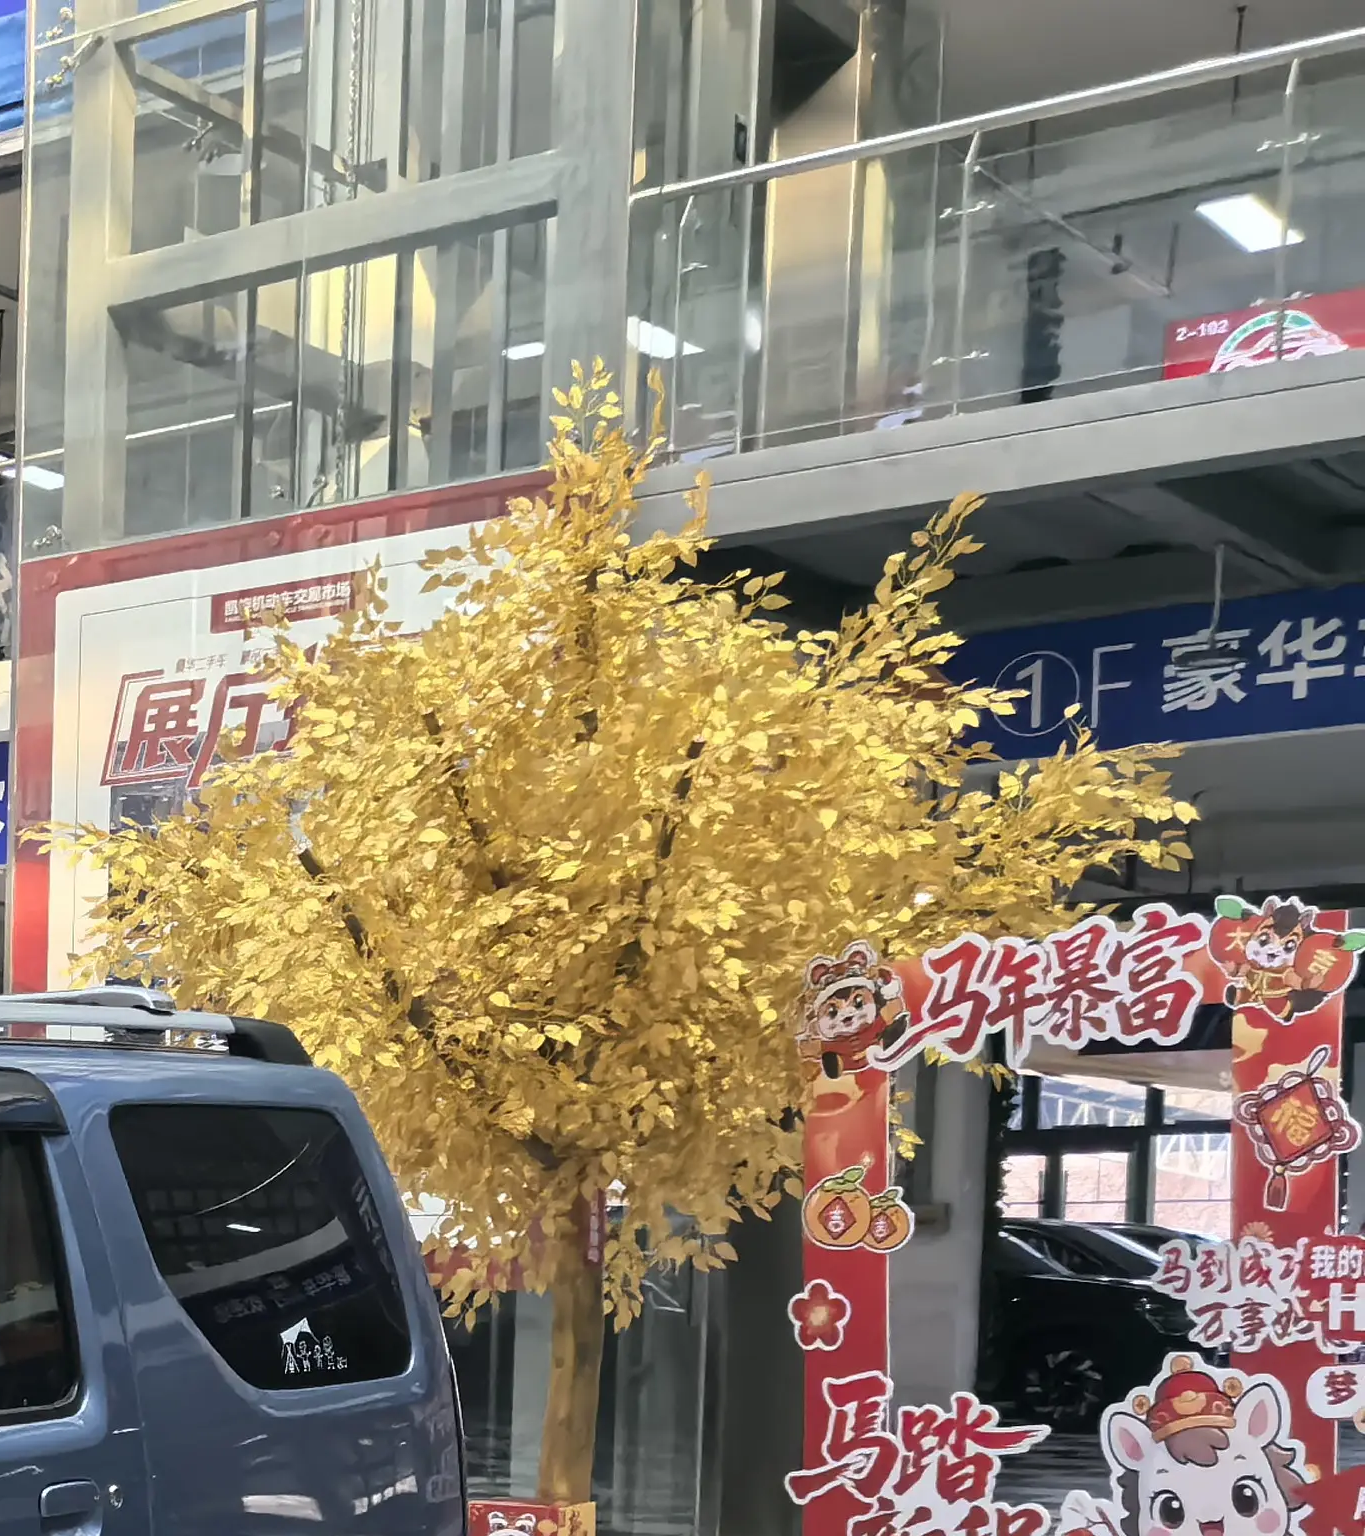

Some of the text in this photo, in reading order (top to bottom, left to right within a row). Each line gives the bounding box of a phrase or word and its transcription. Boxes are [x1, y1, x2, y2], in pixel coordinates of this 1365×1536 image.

[1161, 616, 1365, 713] 豪华
[875, 909, 1205, 1061] 马年暴富
